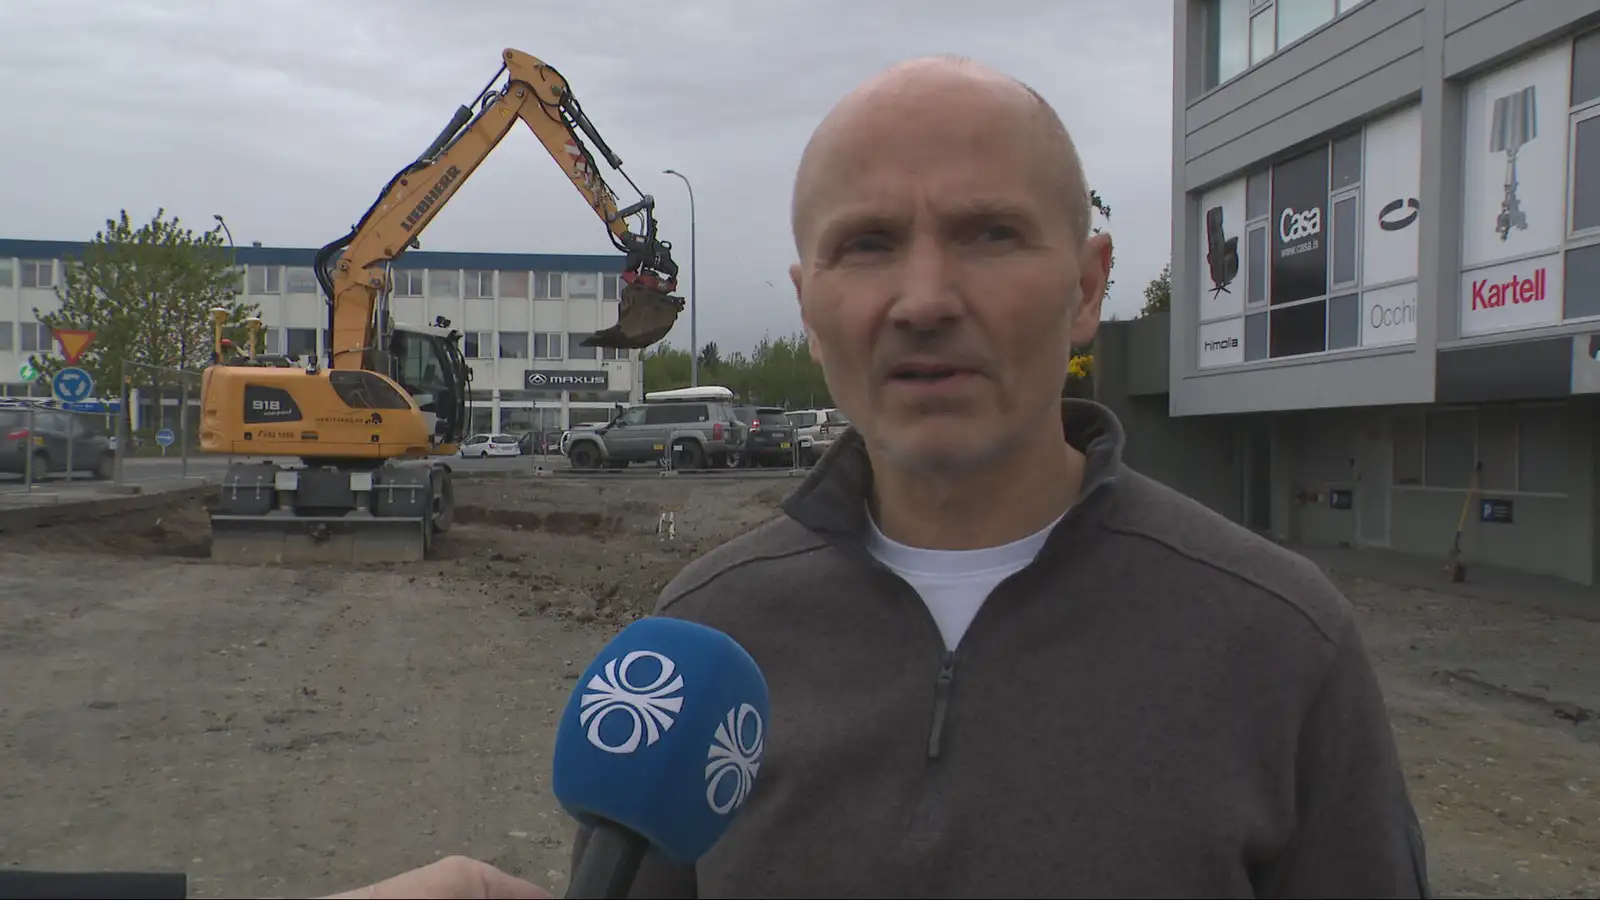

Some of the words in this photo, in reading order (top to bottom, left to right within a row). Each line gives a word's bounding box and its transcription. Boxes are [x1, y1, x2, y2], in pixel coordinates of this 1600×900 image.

[400, 165, 461, 232] LIEBHERR
[1280, 207, 1320, 243] Casa
[1472, 268, 1546, 310] Kartell
[550, 376, 605, 384] MAXUS
[252, 400, 280, 410] 918
